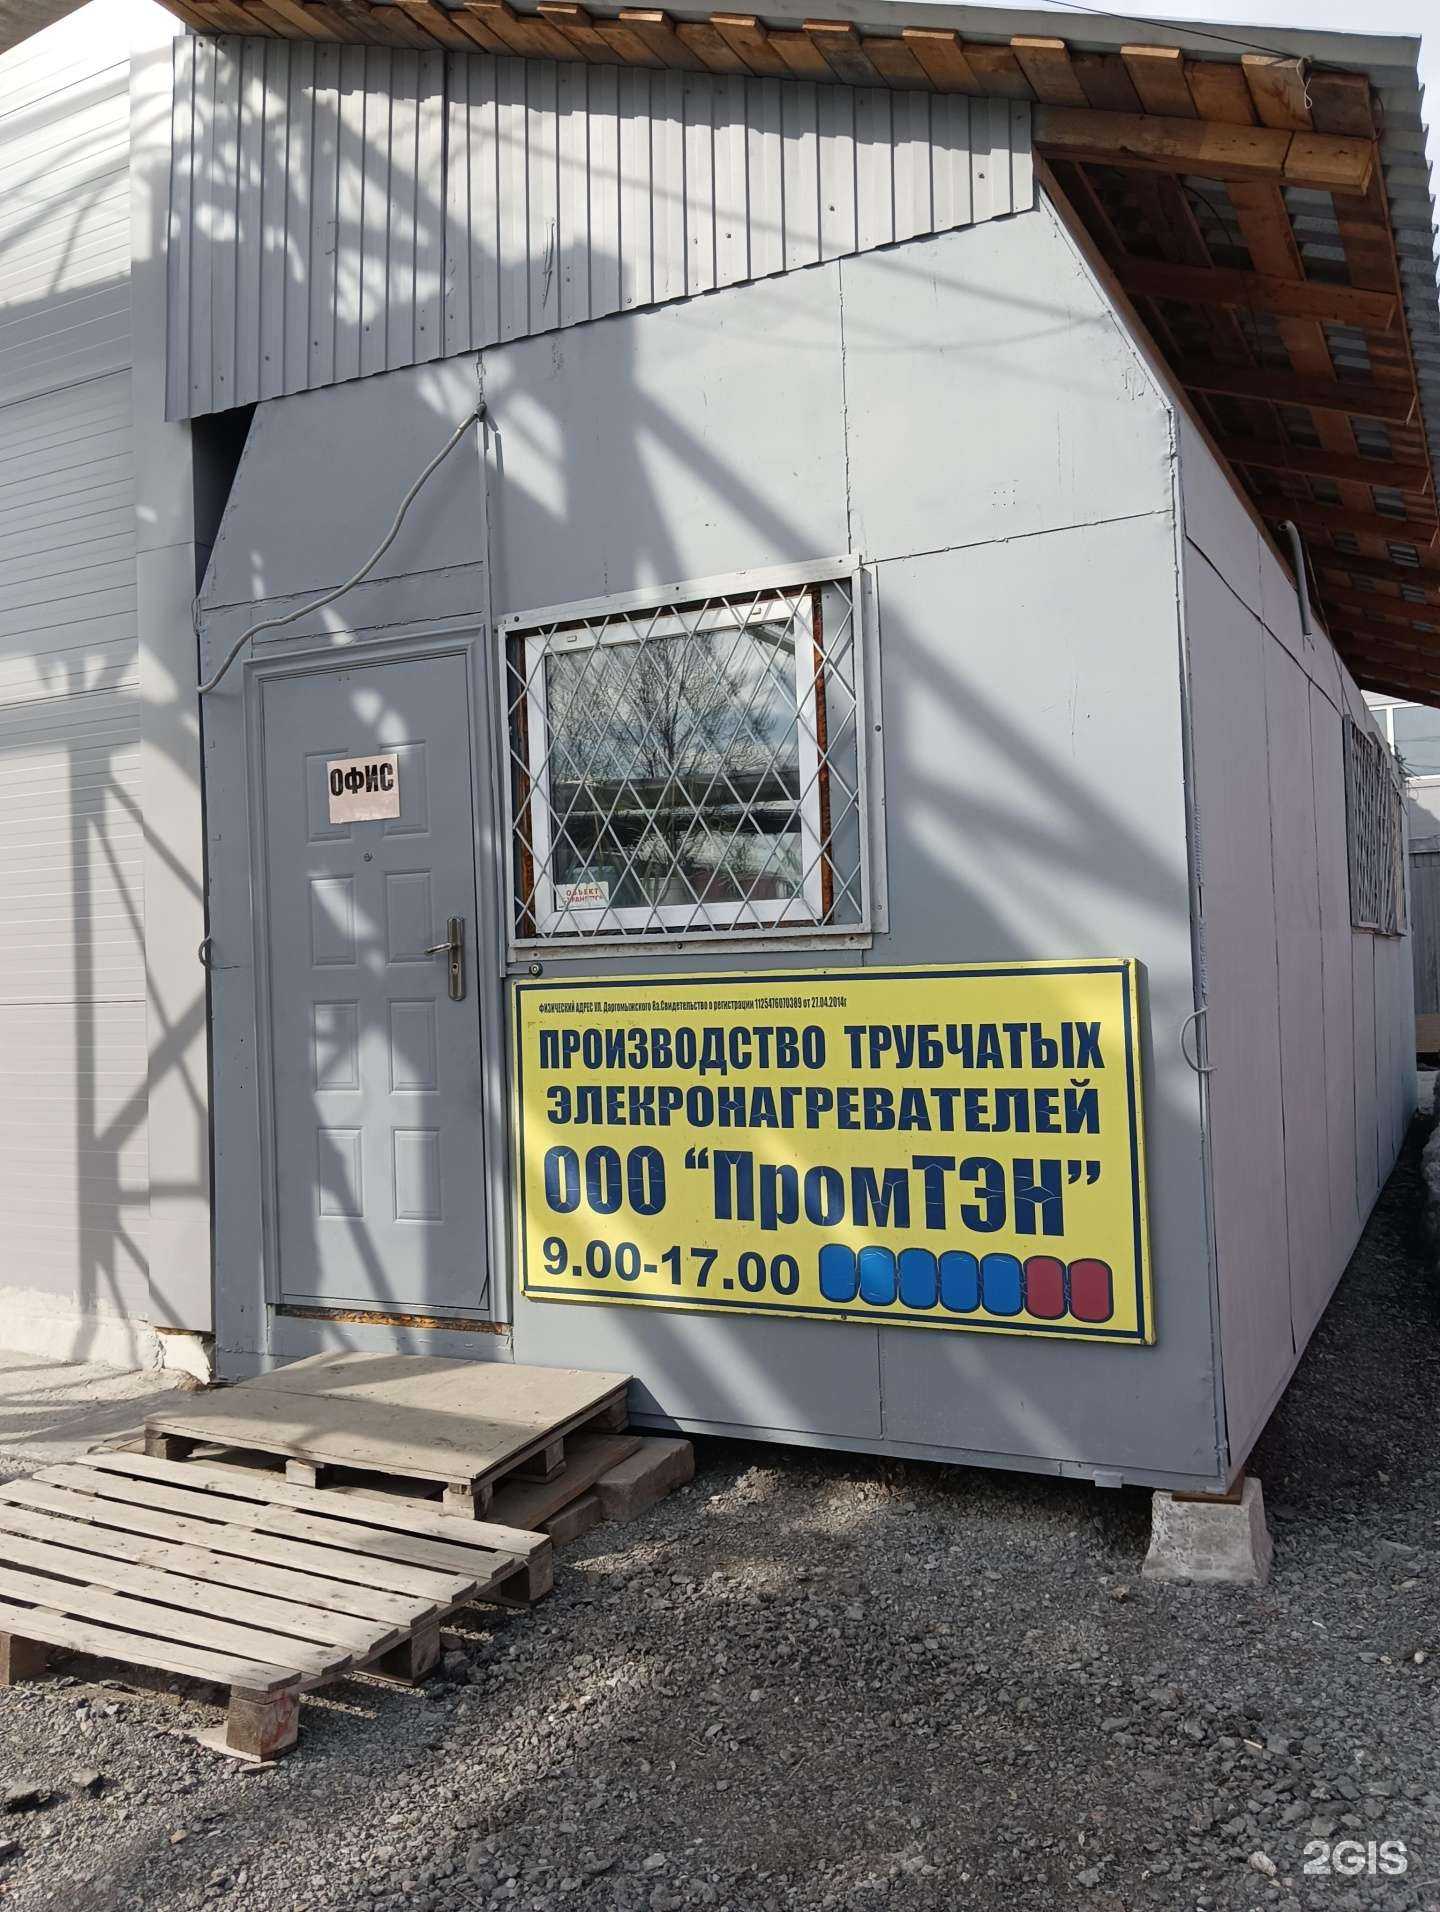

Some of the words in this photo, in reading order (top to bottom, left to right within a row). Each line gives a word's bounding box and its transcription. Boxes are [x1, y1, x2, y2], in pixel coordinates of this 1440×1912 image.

[330, 763, 394, 797] ОФИС
[575, 1002, 594, 1014] АДРЕС
[714, 1000, 754, 1011] регистрации
[803, 998, 811, 1008] от
[539, 1025, 825, 1076] ПРОИЗВОДСТВО
[844, 1021, 1105, 1069] ТРУБЧАТЫХ
[547, 1079, 1101, 1134] ЭЛЕКРОНАГРЕВАТЕЛЕЙ
[544, 1145, 666, 1216] ООО
[543, 1237, 800, 1296] 9.00-17.00
